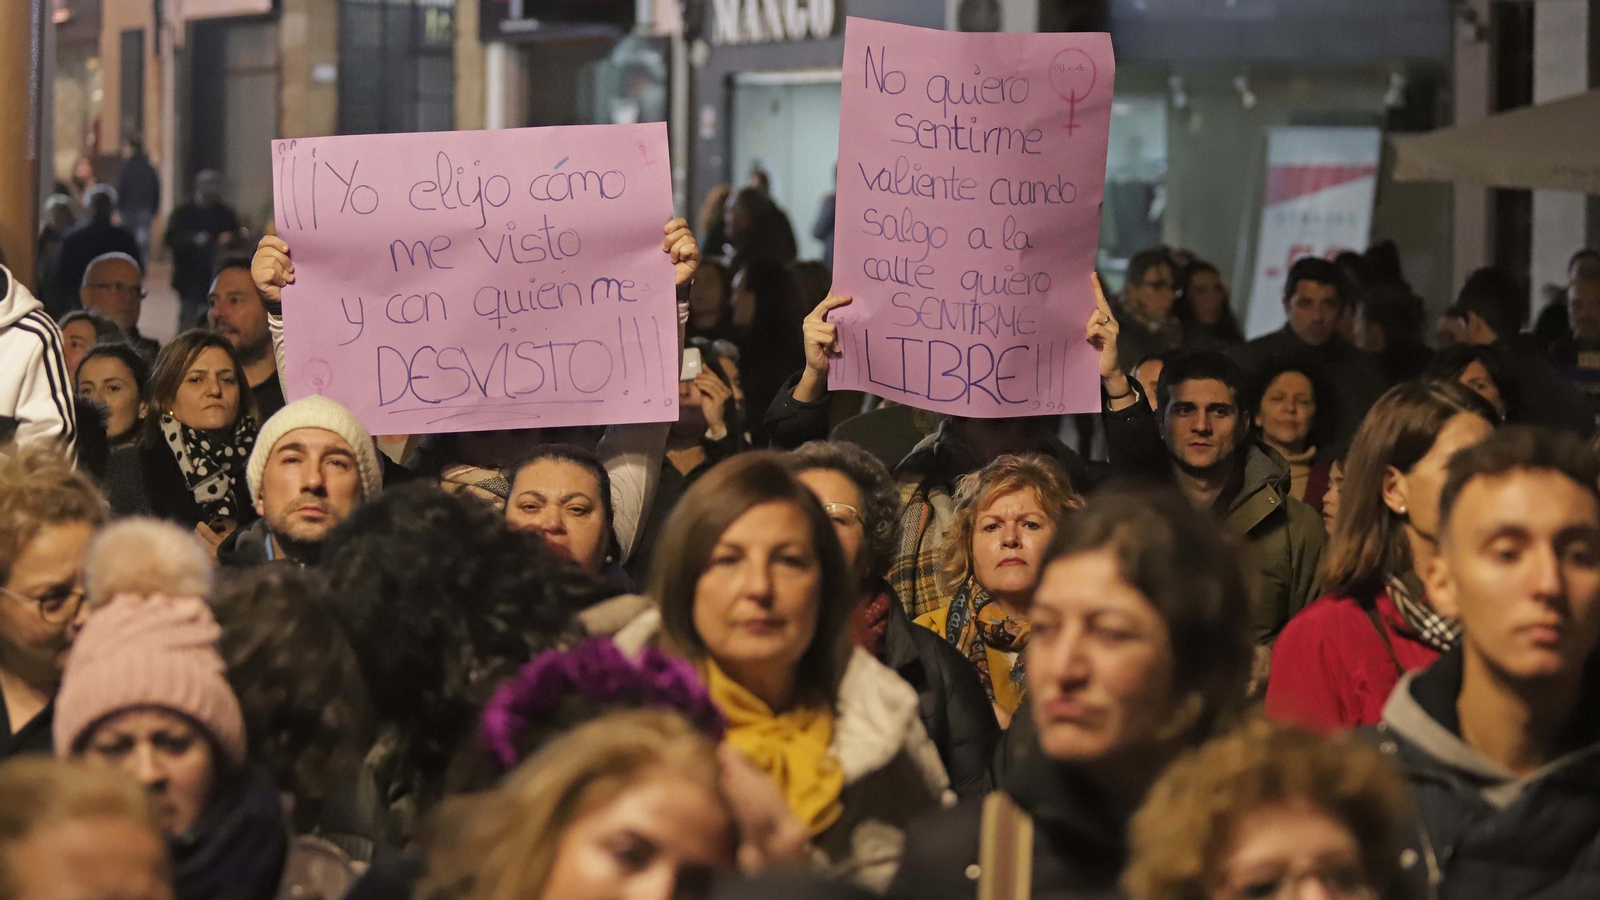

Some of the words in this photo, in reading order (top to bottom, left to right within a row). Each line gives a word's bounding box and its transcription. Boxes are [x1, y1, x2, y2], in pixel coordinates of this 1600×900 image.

[864, 45, 907, 94] No
[926, 64, 1030, 118] quiero
[408, 150, 511, 230] elijo
[529, 156, 626, 201] cómo
[858, 155, 977, 200] valiente
[989, 174, 1077, 205] cuando
[390, 235, 454, 272] me
[478, 214, 581, 264] visto
[968, 227, 992, 249] a
[1003, 214, 1033, 250] la
[863, 255, 935, 289] calle
[960, 265, 1051, 304] quiero
[339, 296, 364, 346] y
[386, 292, 447, 324] con
[473, 270, 582, 329] quién
[591, 277, 638, 305] me
[891, 292, 1036, 338] SENTIRME
